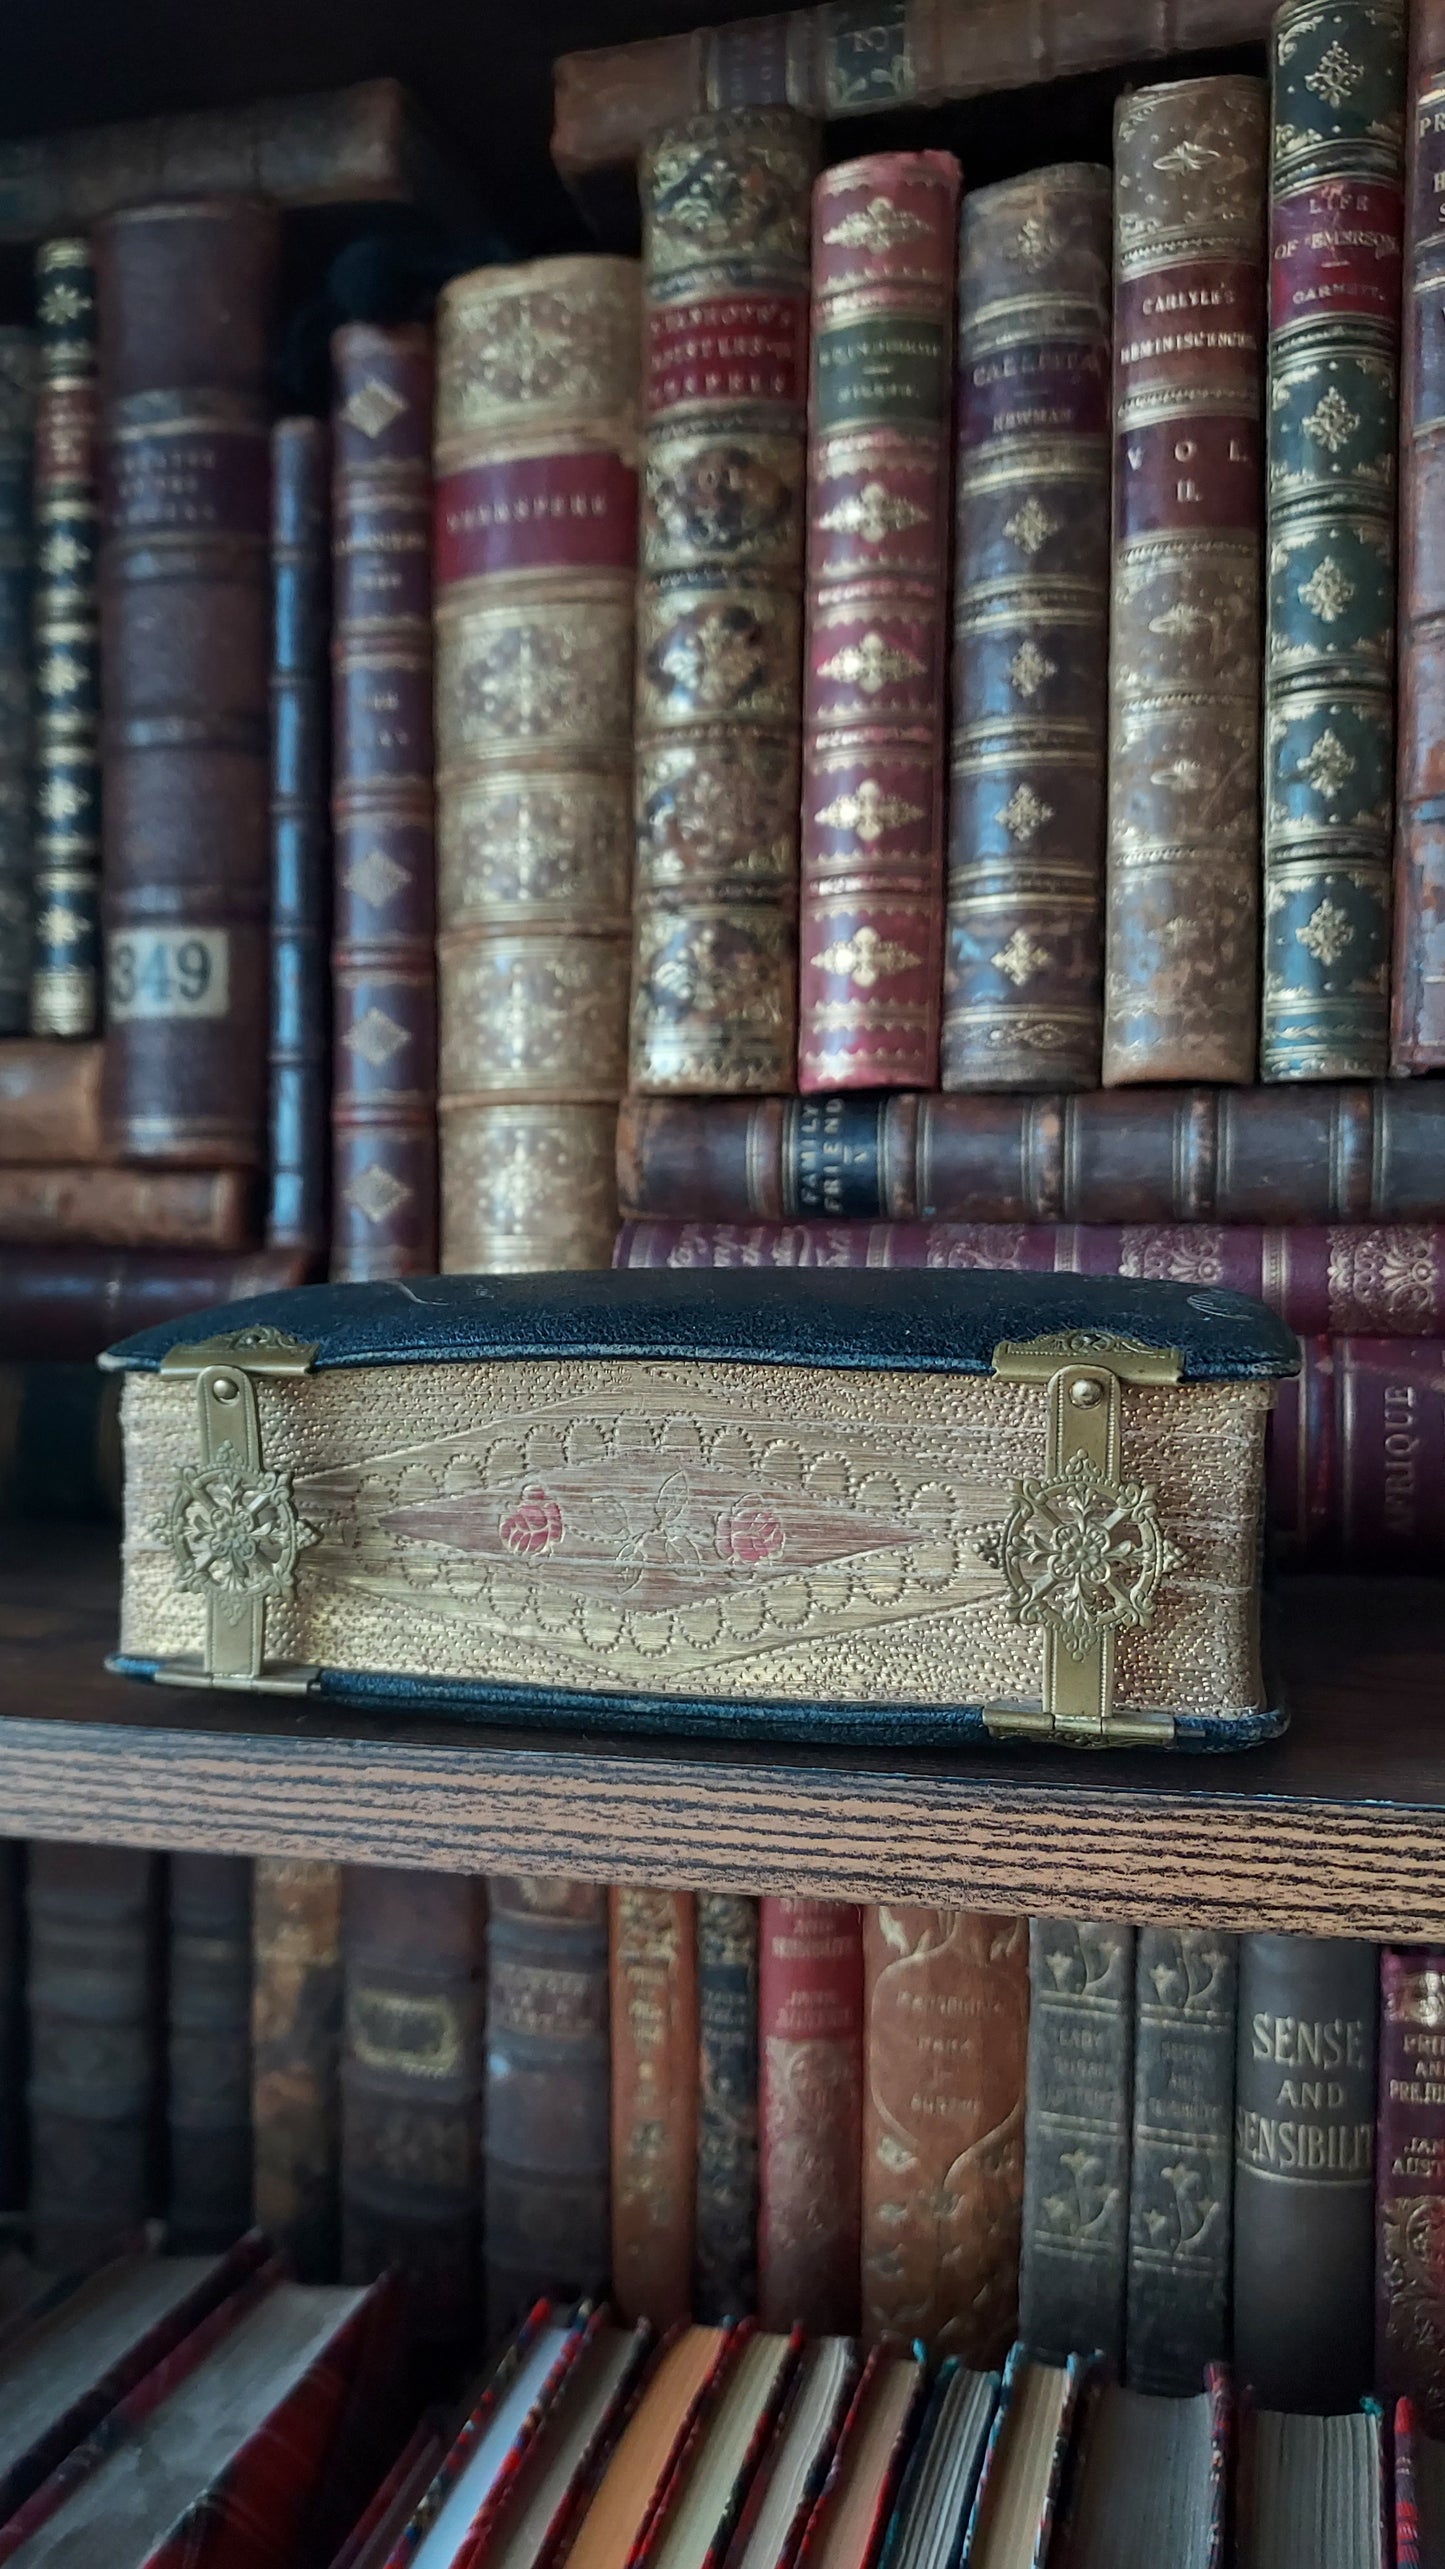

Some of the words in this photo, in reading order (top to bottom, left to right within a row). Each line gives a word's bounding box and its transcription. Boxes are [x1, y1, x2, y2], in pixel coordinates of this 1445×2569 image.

[1274, 239, 1299, 260] OF
[1143, 282, 1236, 315] CARLYLE'S
[111, 940, 212, 1005] 349
[801, 1104, 818, 1203] FAMILY
[823, 1098, 844, 1212] FRIEND
[1252, 2012, 1365, 2071] SENSE
[1276, 2079, 1345, 2112] AND
